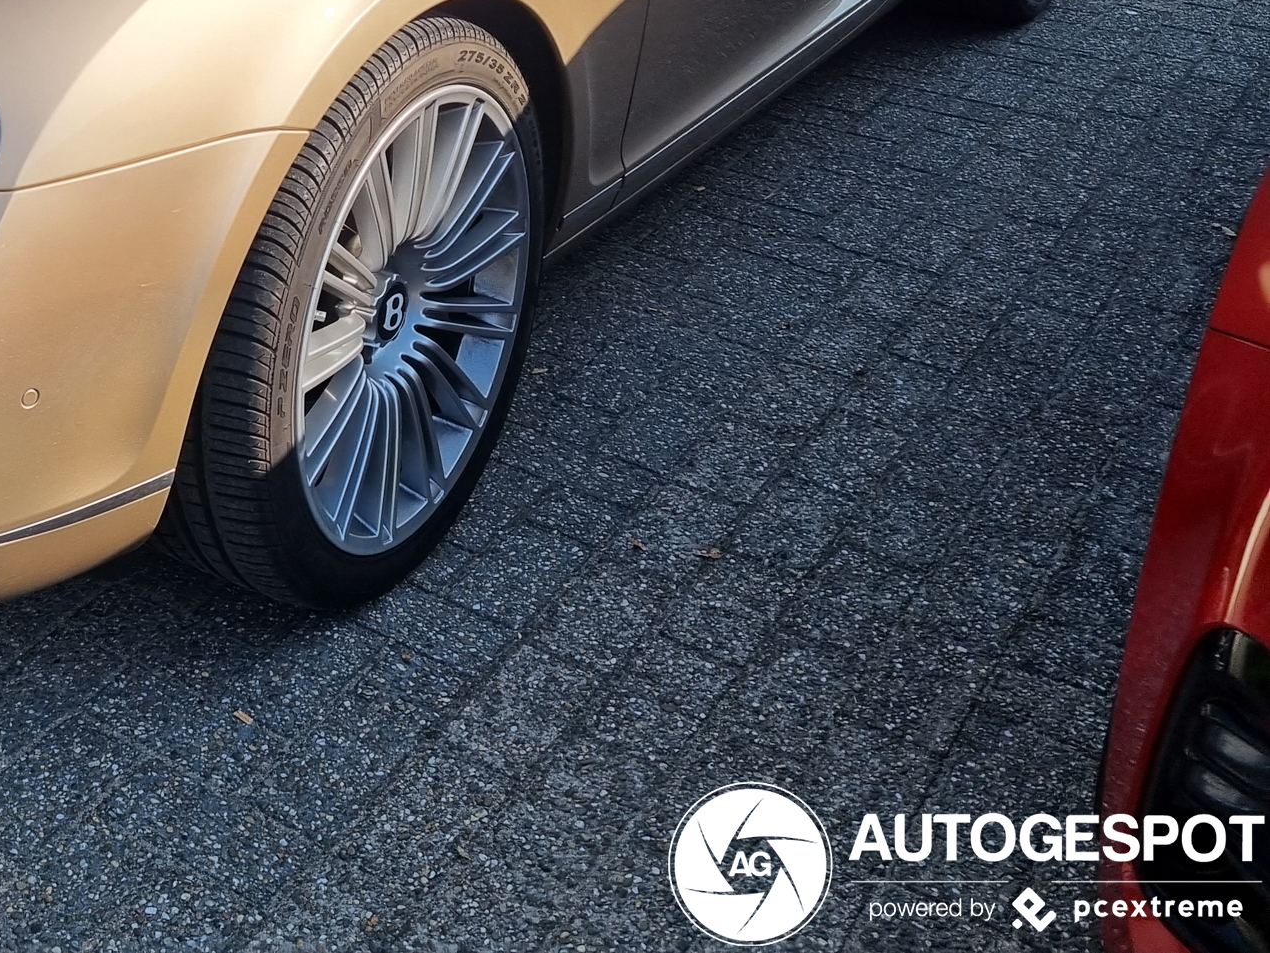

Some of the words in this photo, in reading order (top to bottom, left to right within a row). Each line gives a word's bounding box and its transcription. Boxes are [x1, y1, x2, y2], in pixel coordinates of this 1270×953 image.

[457, 50, 505, 74] 275/35
[503, 71, 520, 94] ZR
[279, 295, 301, 393] ZERO
